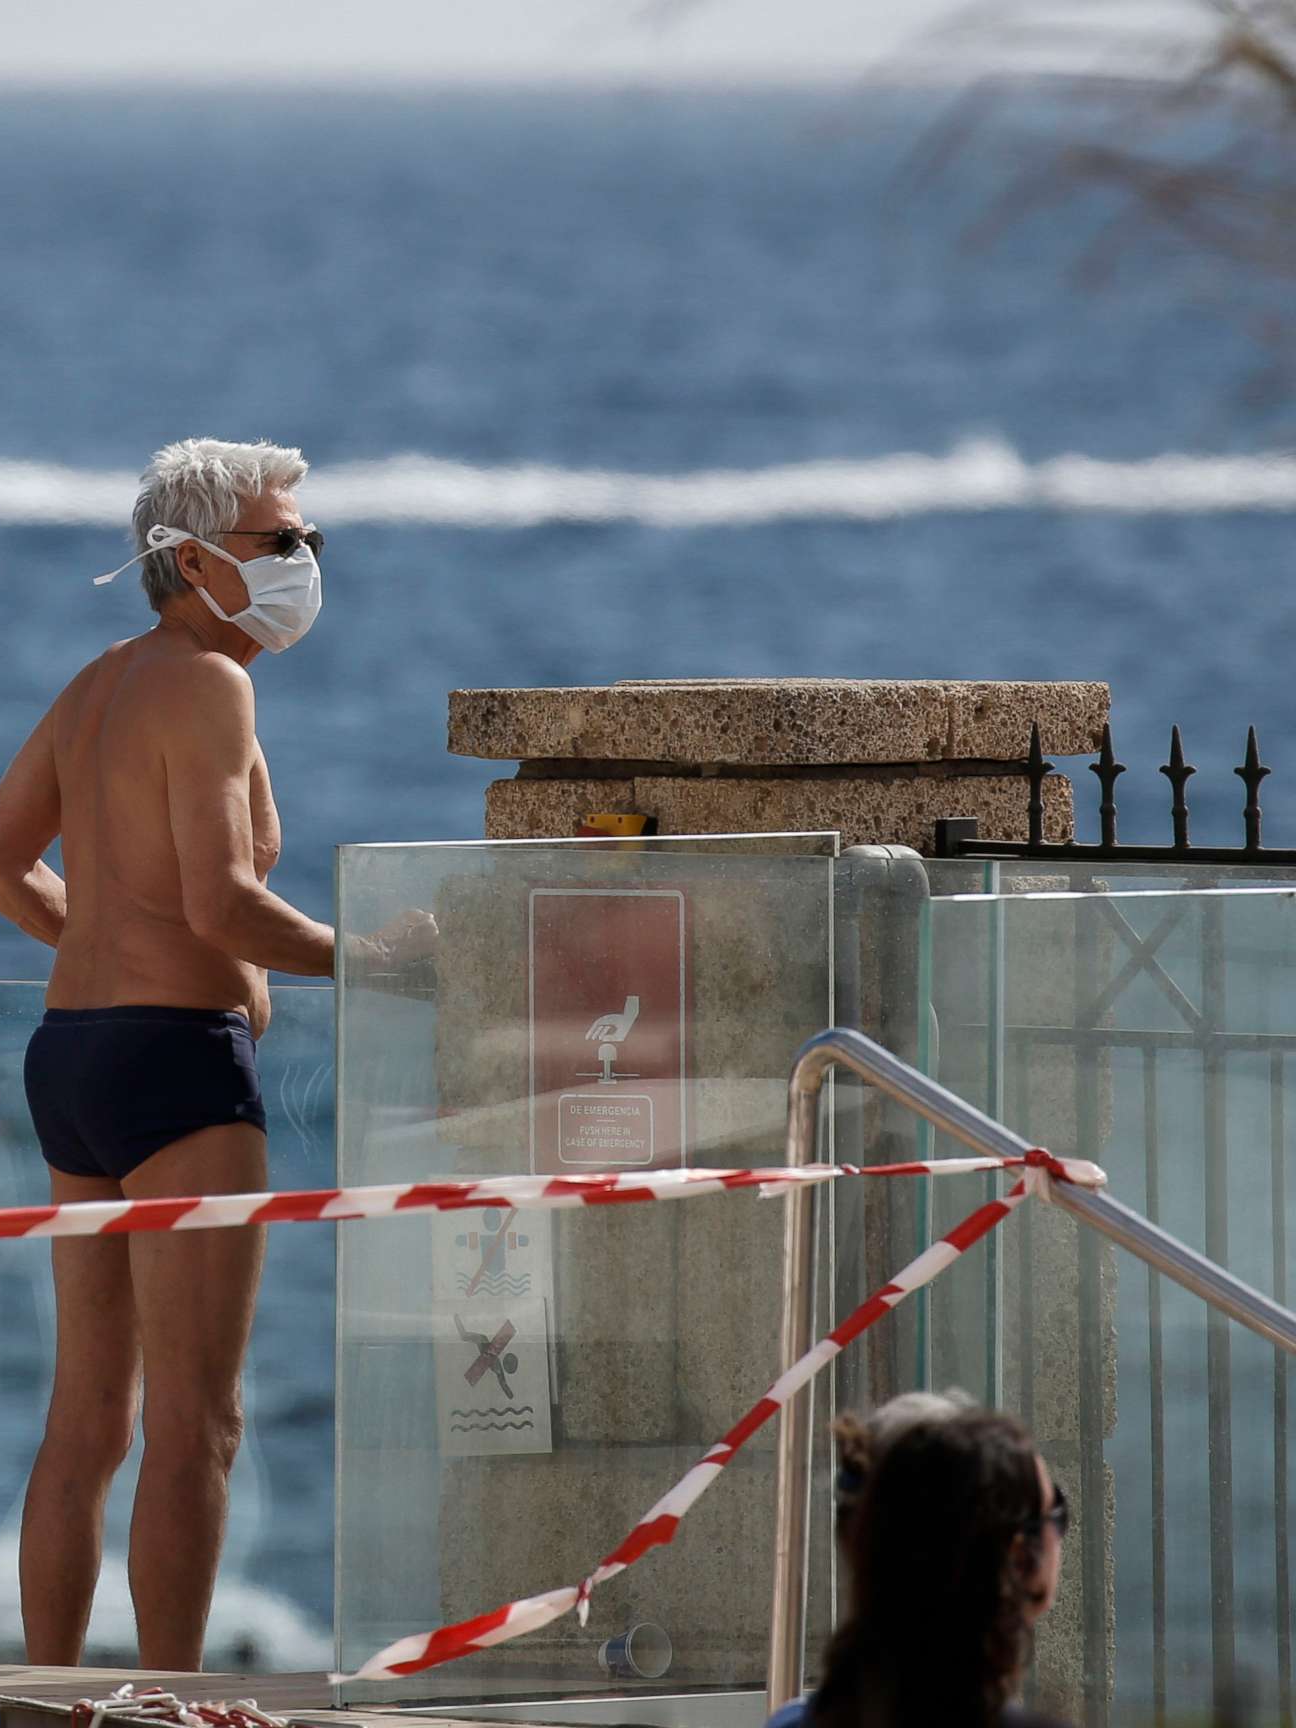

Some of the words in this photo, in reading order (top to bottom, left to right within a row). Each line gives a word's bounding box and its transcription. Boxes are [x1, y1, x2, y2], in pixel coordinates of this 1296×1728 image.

[570, 1105, 582, 1114] DE
[584, 1105, 641, 1116] EMERGENCIA
[579, 1126, 600, 1136] PUSH
[601, 1127, 622, 1137] HERE
[566, 1138, 586, 1148] CASE
[599, 1138, 646, 1149] EMERGENCY
